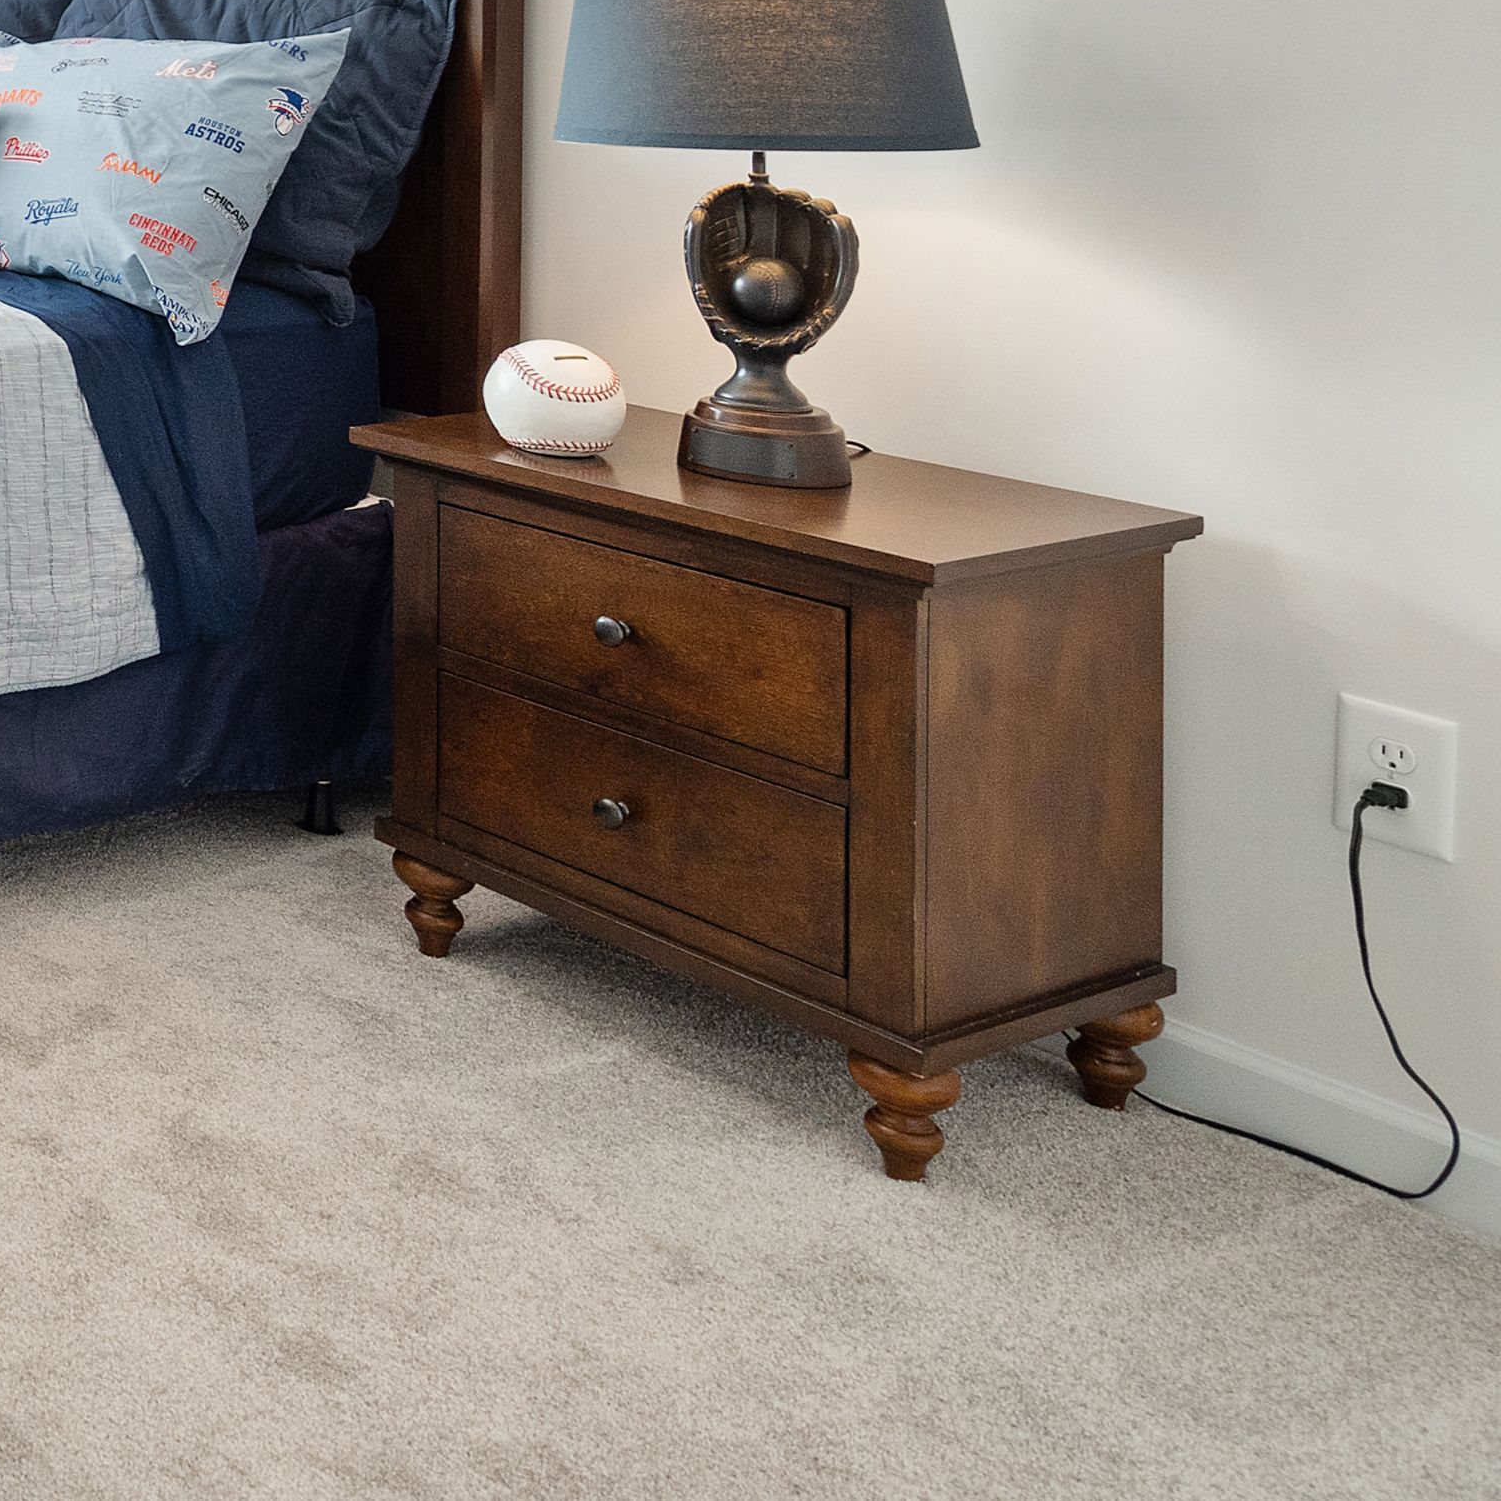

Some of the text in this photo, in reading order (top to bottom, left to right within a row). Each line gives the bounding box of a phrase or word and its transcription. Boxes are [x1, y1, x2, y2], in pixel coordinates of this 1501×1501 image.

[155, 59, 218, 81] Mets
[184, 123, 245, 154] ASTROS
[198, 116, 243, 138] HOUSTON
[1, 137, 49, 163] Phillies
[96, 151, 163, 186] MIAMI
[24, 197, 79, 226] Royals
[203, 186, 250, 231] CHICAGO
[128, 213, 198, 253] CINCINNATI
[139, 232, 176, 257] REDS
[65, 259, 123, 286] New York
